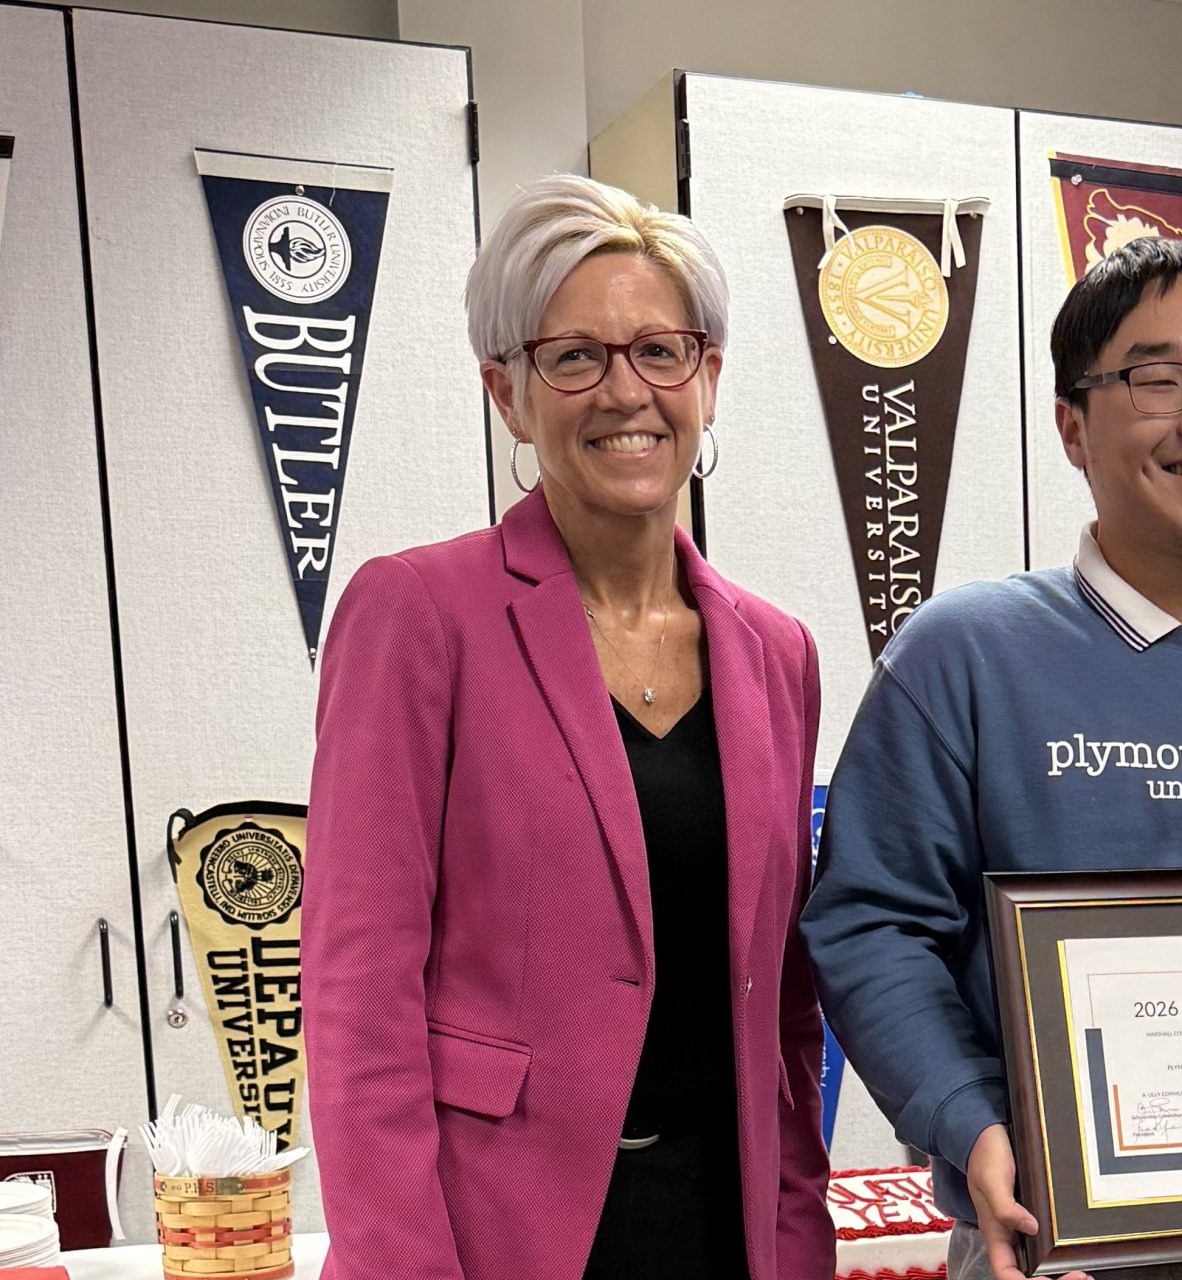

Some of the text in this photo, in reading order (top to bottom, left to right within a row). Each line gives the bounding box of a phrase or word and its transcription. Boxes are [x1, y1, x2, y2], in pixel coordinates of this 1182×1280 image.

[253, 205, 293, 291] INDIANAPOLIS 1855
[297, 206, 340, 293] BUTLER UNIVERSITY
[829, 274, 843, 314] 1859
[847, 310, 938, 357] UNIVERSITY
[242, 305, 357, 580] BUTLER
[862, 384, 887, 635] UNIVERSITY
[207, 948, 262, 1127] UNIVERSI
[1133, 1000, 1179, 1018] 2026
